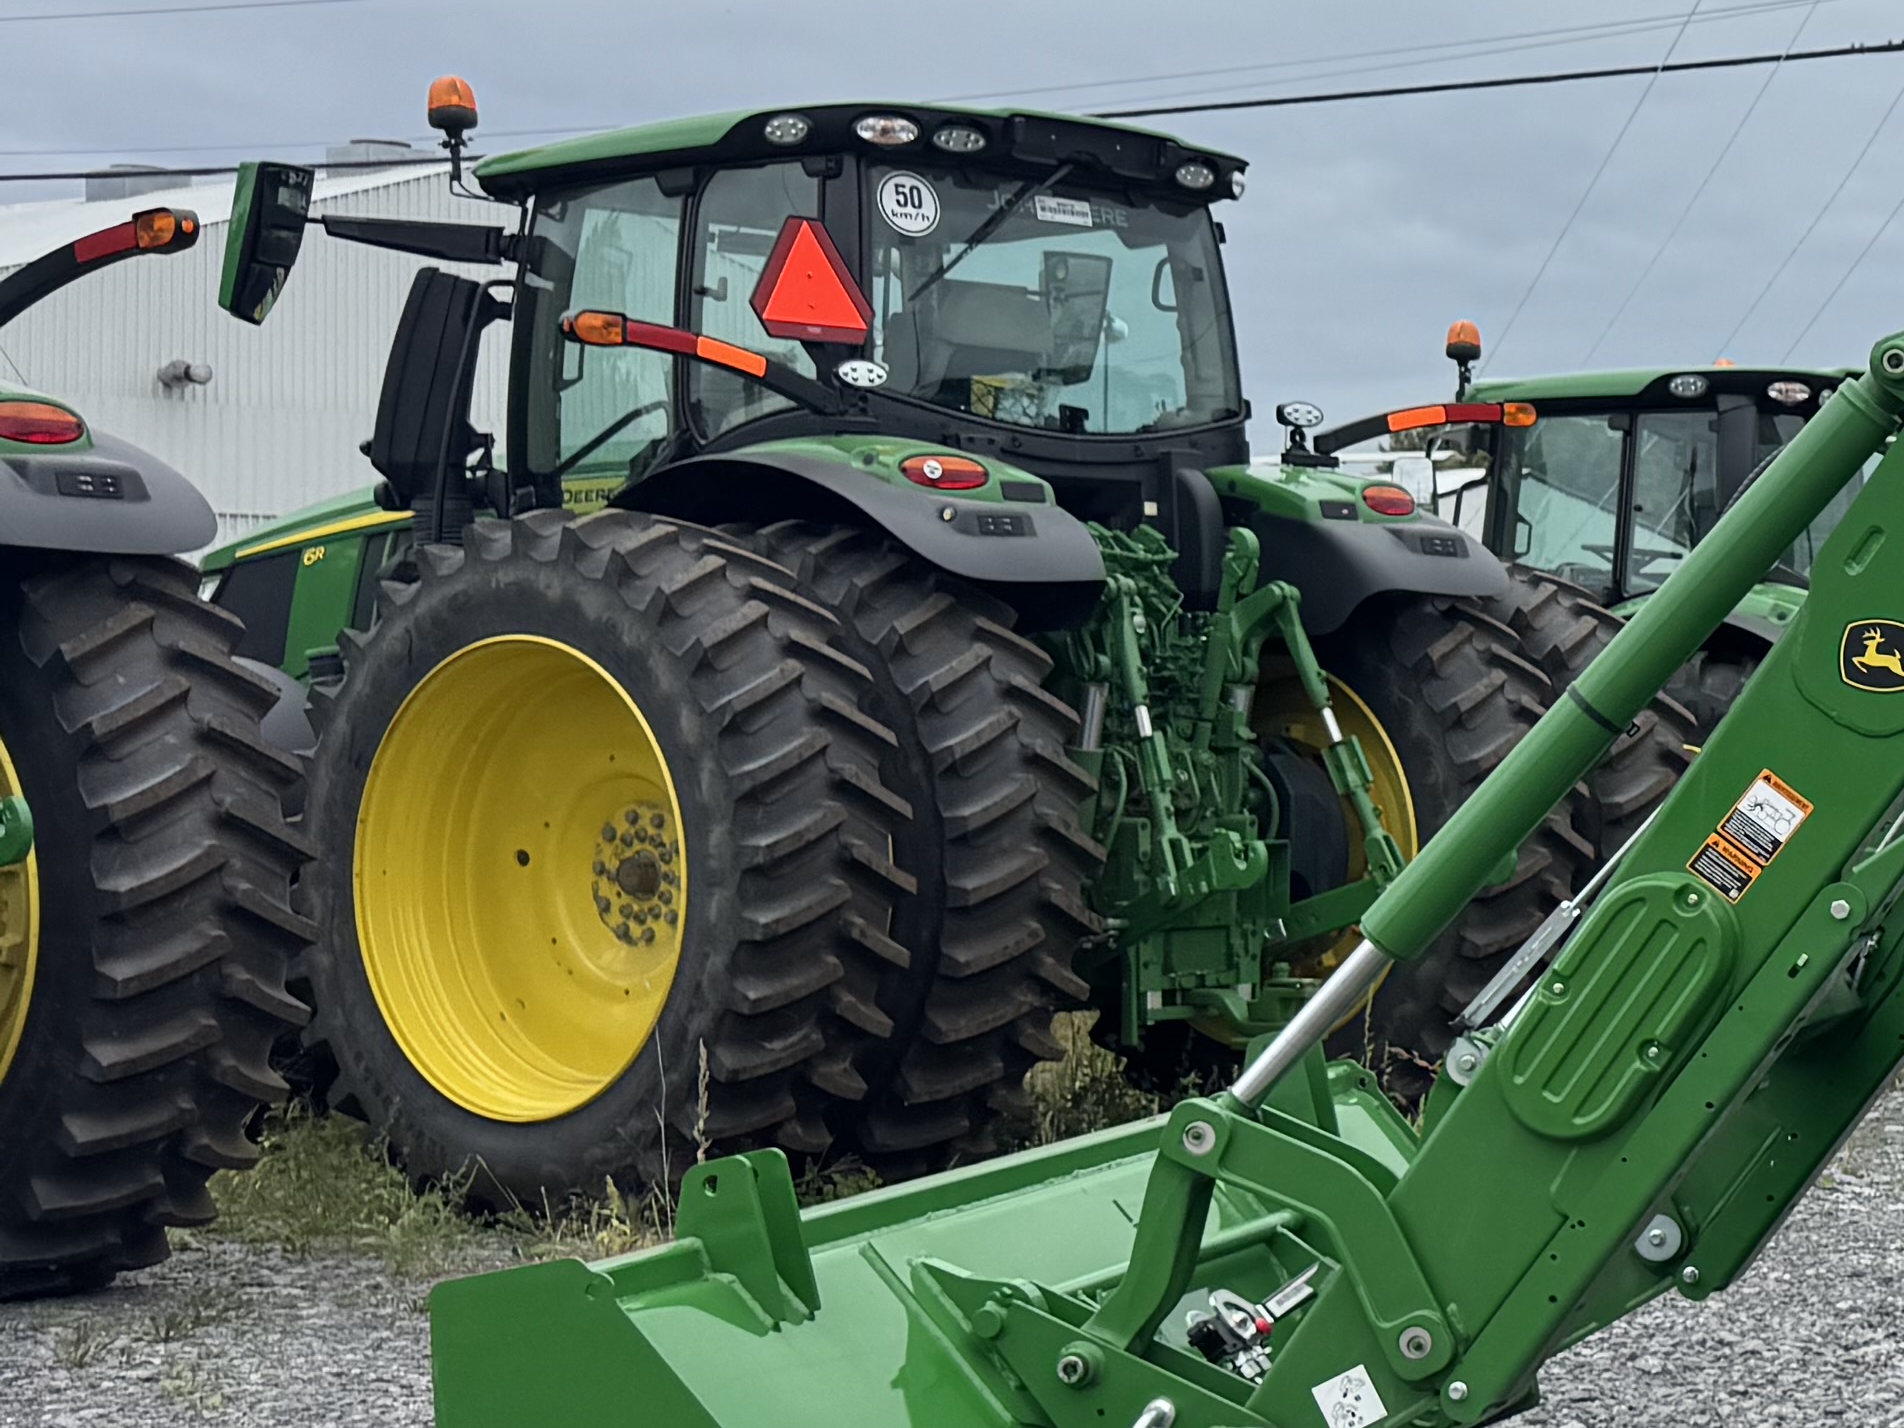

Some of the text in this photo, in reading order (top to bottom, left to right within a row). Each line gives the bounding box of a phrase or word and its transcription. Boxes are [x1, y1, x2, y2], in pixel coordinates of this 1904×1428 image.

[893, 182, 924, 210] 50
[890, 207, 931, 223] km/h
[303, 546, 326, 566] 6R
[1720, 845, 1754, 874] WARNING
